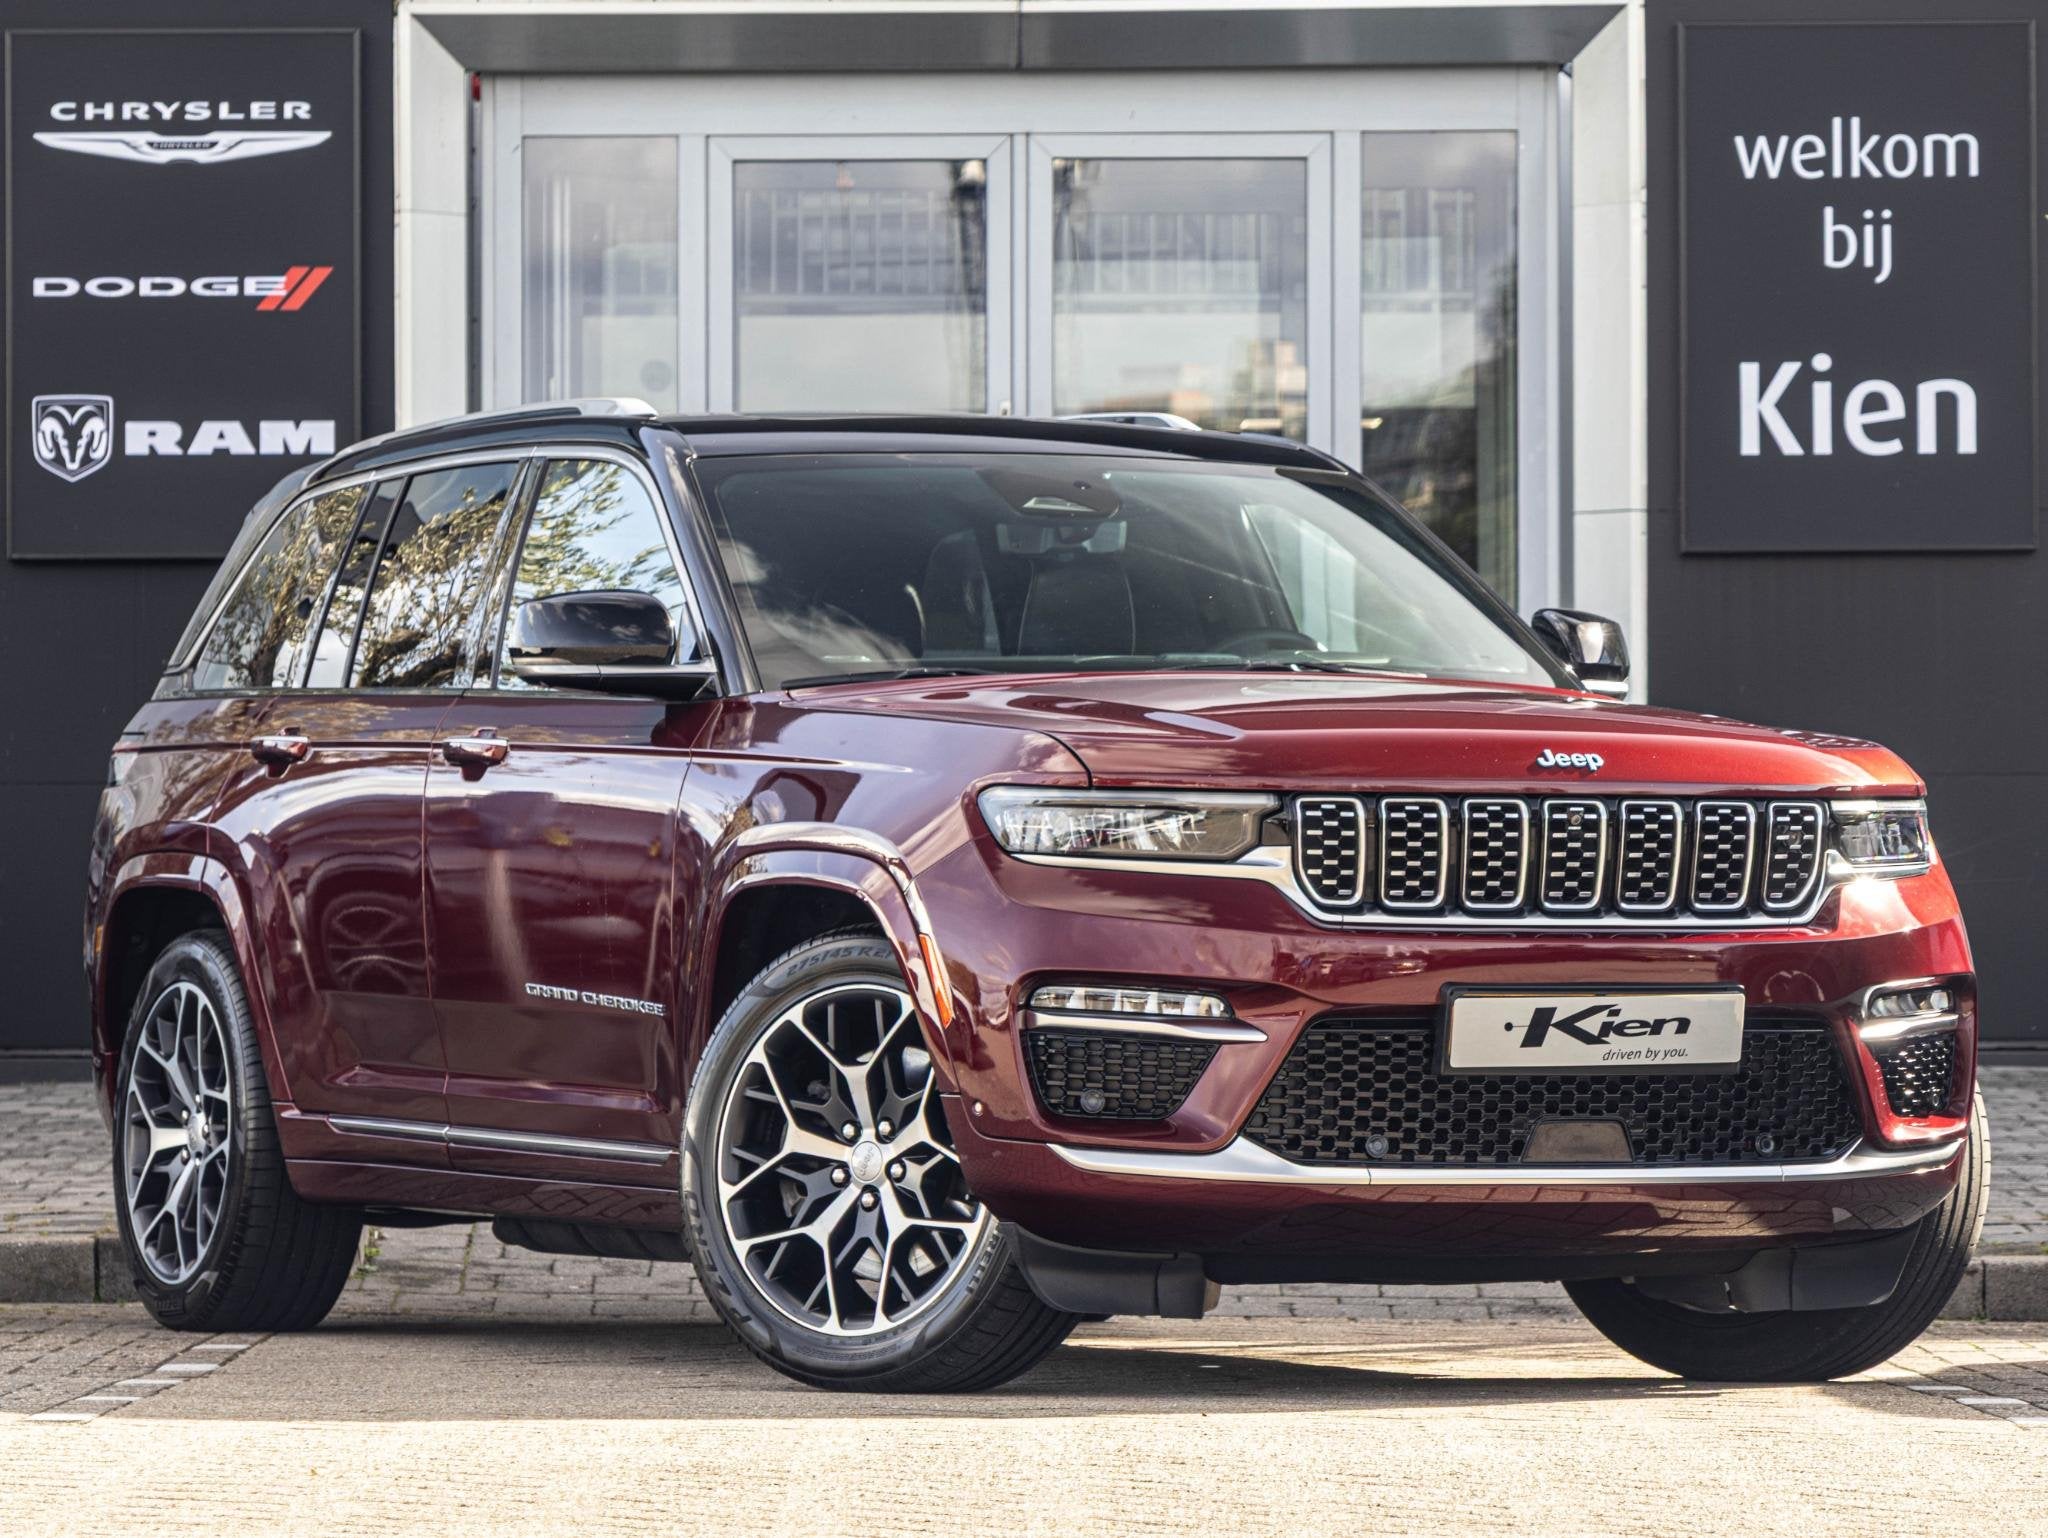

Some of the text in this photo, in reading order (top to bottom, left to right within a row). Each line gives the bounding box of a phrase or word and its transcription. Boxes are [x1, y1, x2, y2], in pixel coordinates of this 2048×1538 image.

[50, 101, 312, 121] CHRYSLER
[1733, 116, 1980, 179] welkom
[1823, 206, 1893, 284] bij
[32, 276, 289, 298] DODGE
[1739, 352, 1978, 456] Kien
[124, 420, 336, 456] RAM
[1537, 748, 1605, 771] Jeep
[525, 982, 667, 1017] GRAND CHEROKEE
[1519, 1003, 1692, 1049] Kien
[1602, 1047, 1689, 1062] driven by you.
